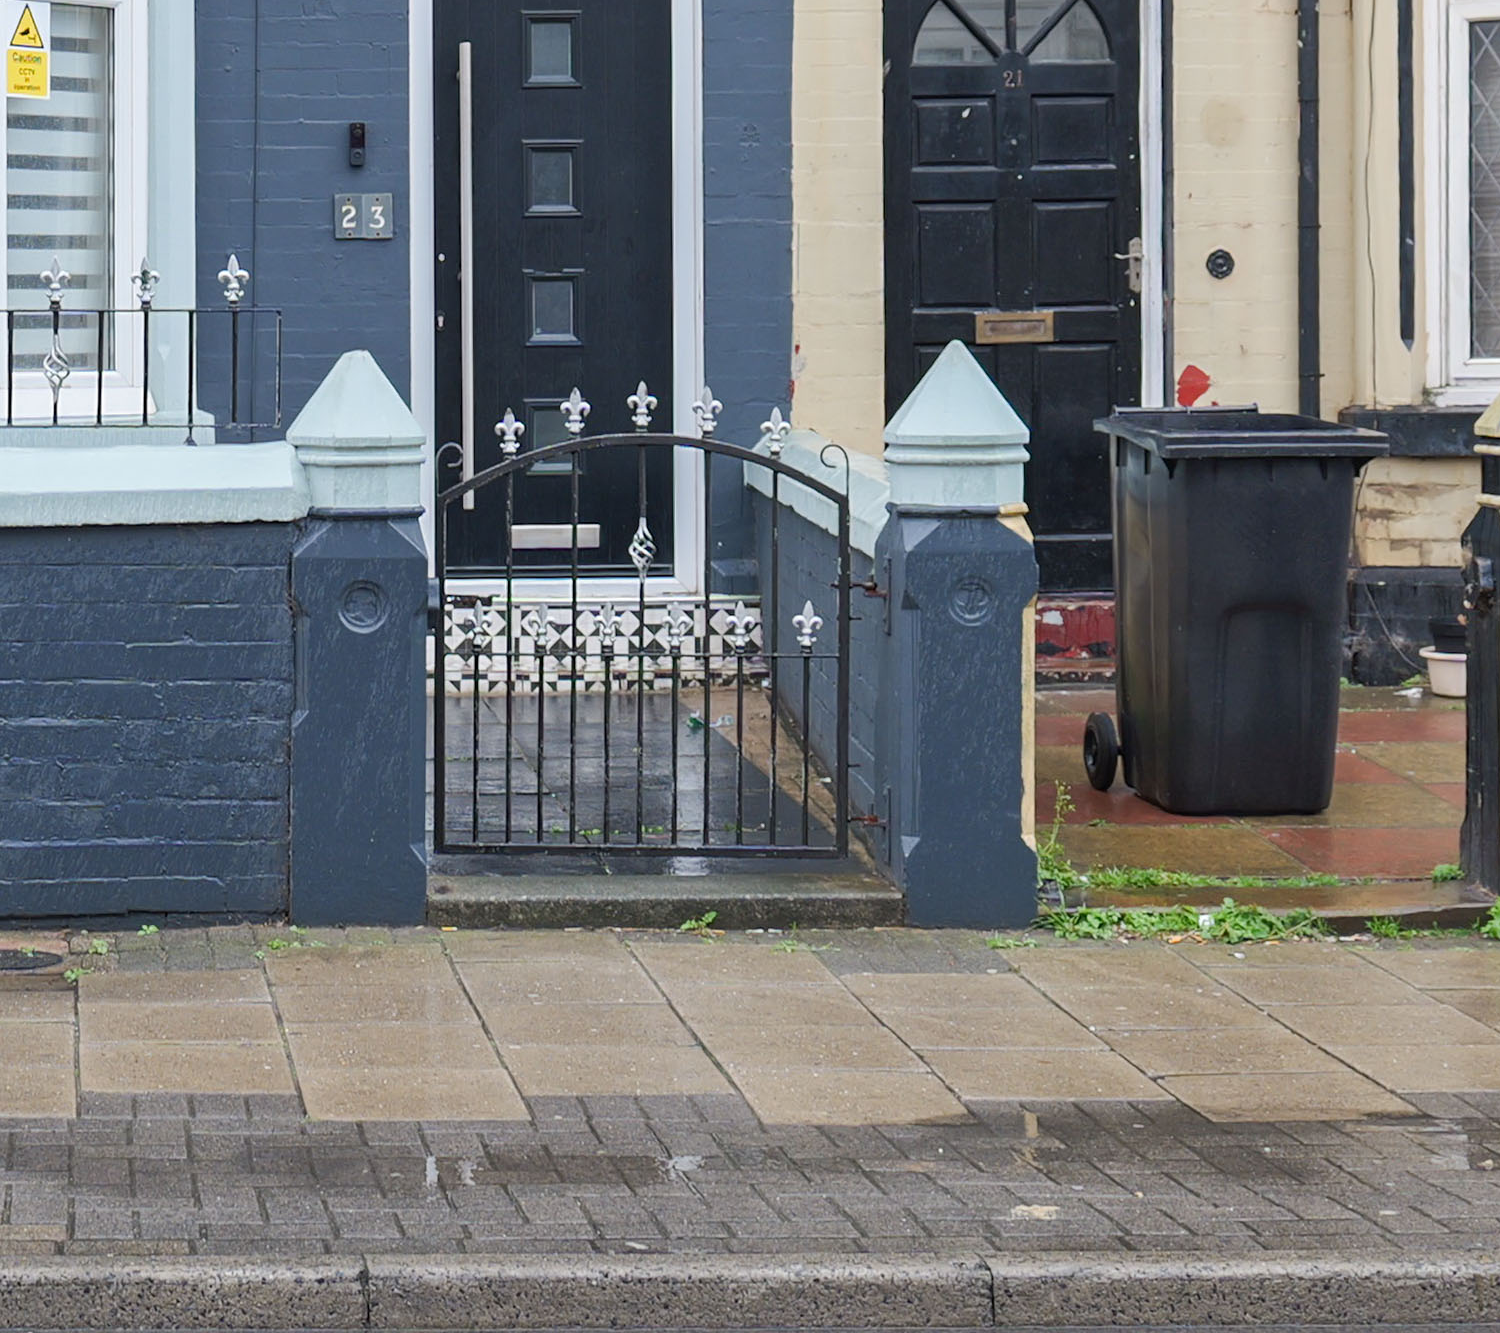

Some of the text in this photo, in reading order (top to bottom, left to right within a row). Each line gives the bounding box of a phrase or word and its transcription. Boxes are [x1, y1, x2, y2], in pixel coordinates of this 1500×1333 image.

[12, 51, 42, 64] Caution
[18, 67, 36, 76] CCTV
[1003, 69, 1024, 88] 21
[341, 204, 386, 229] 23
